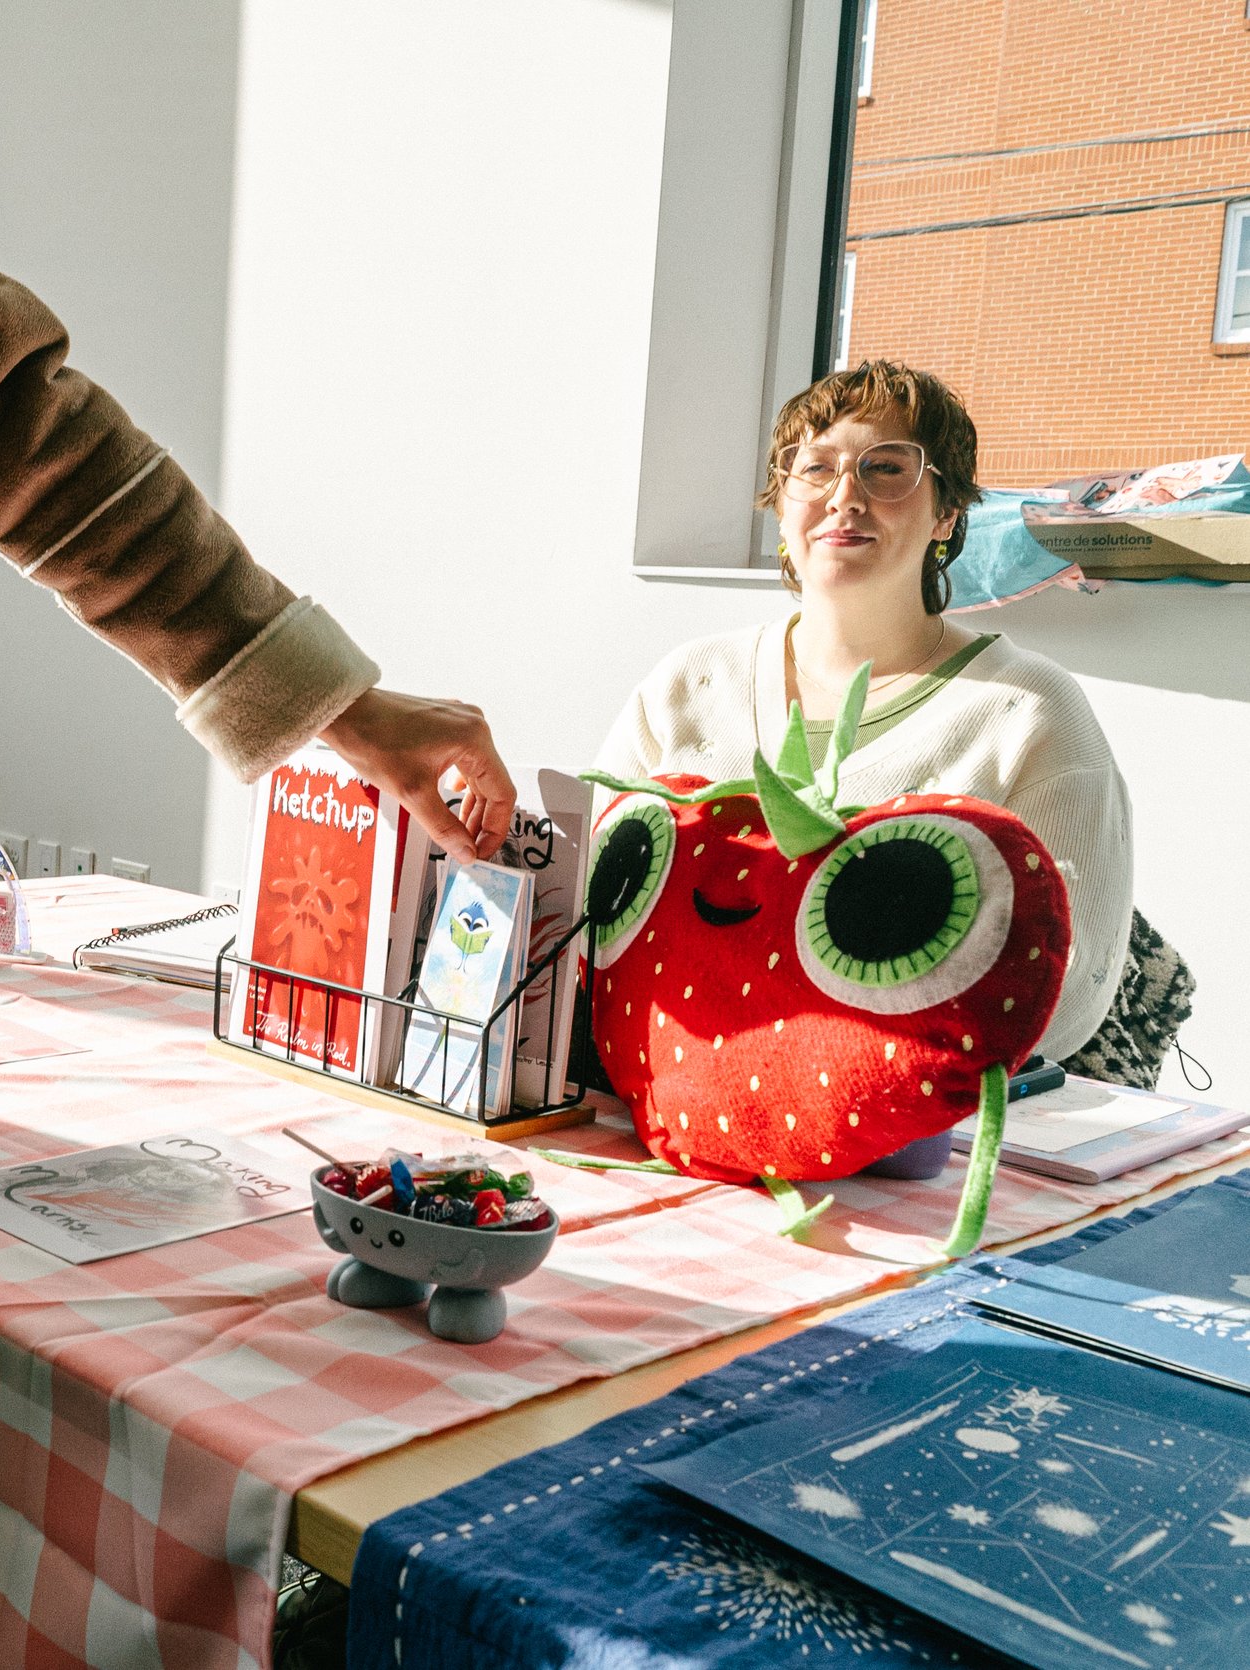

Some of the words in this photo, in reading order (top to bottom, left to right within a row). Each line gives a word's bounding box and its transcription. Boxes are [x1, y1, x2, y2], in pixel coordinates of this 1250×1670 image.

[1039, 536, 1070, 547] entre
[1074, 534, 1090, 547] de
[1091, 533, 1153, 546] solutions
[273, 775, 375, 844] Ketchup
